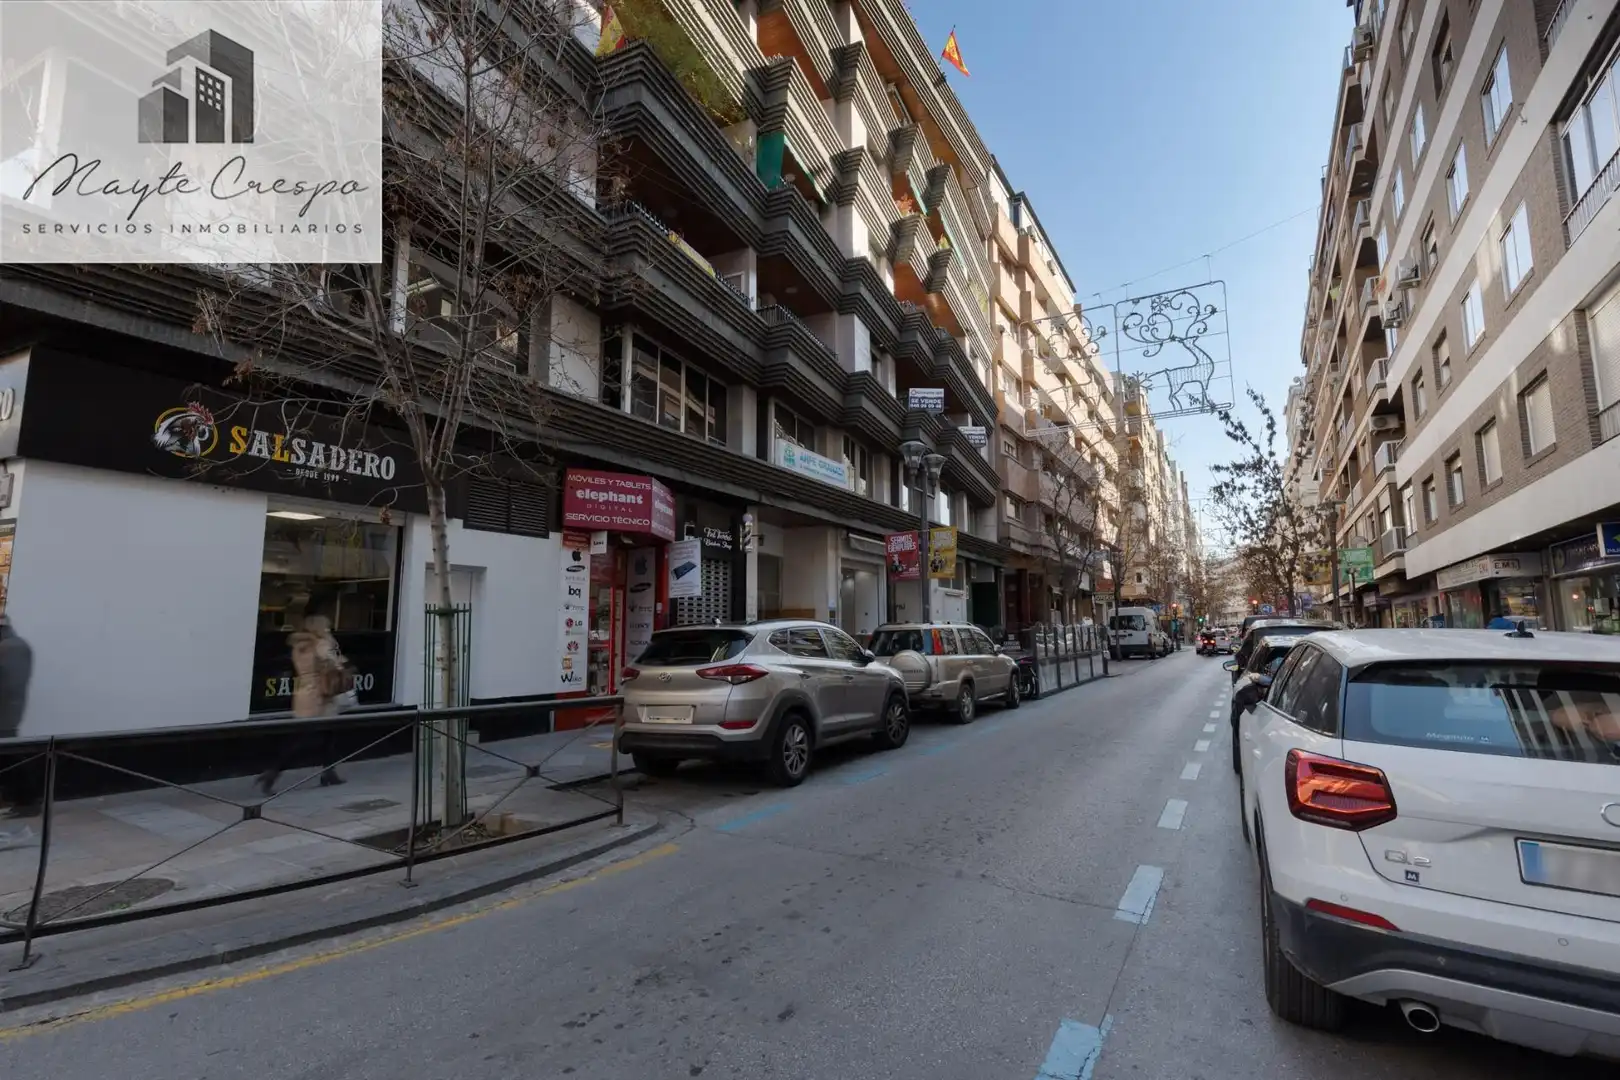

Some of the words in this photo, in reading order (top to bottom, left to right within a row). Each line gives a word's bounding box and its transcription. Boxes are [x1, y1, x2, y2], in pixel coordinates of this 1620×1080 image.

[229, 425, 396, 480] SALSADERO
[615, 480, 651, 490] TABLETS
[576, 489, 643, 505] elephant
[586, 503, 633, 513] DIGITAL
[565, 512, 610, 523] SERVICIO
[612, 515, 651, 526] TÉCNICO
[568, 584, 581, 599] bq
[1384, 849, 1432, 868] Q2
